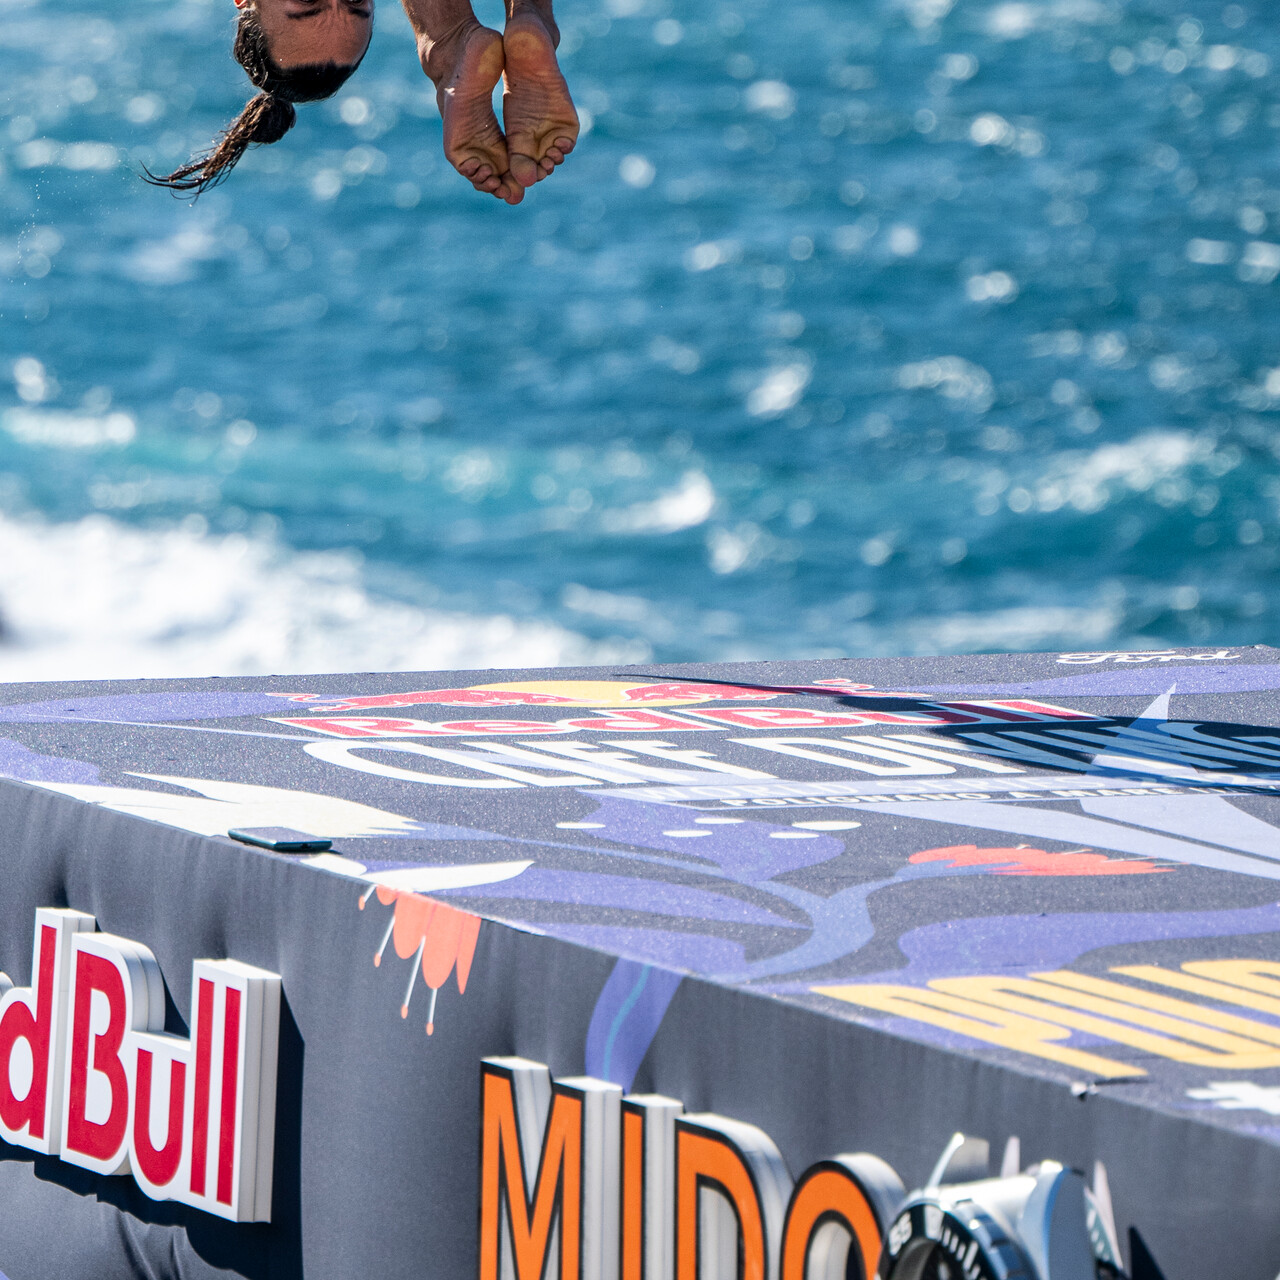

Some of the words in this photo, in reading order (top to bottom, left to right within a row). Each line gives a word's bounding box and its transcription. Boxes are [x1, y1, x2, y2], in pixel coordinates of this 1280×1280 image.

[1056, 651, 1241, 664] Ford
[262, 707, 728, 738] Red
[671, 699, 1112, 730] Bull
[303, 740, 779, 789] CLIFF
[727, 721, 1280, 777] DIVING
[622, 783, 859, 802] WORLD
[875, 775, 1106, 793] SERIES
[721, 792, 991, 807] POLIGNANO
[1009, 790, 1044, 799] A
[1051, 787, 1185, 798] MARE
[64, 941, 247, 1215] Bull
